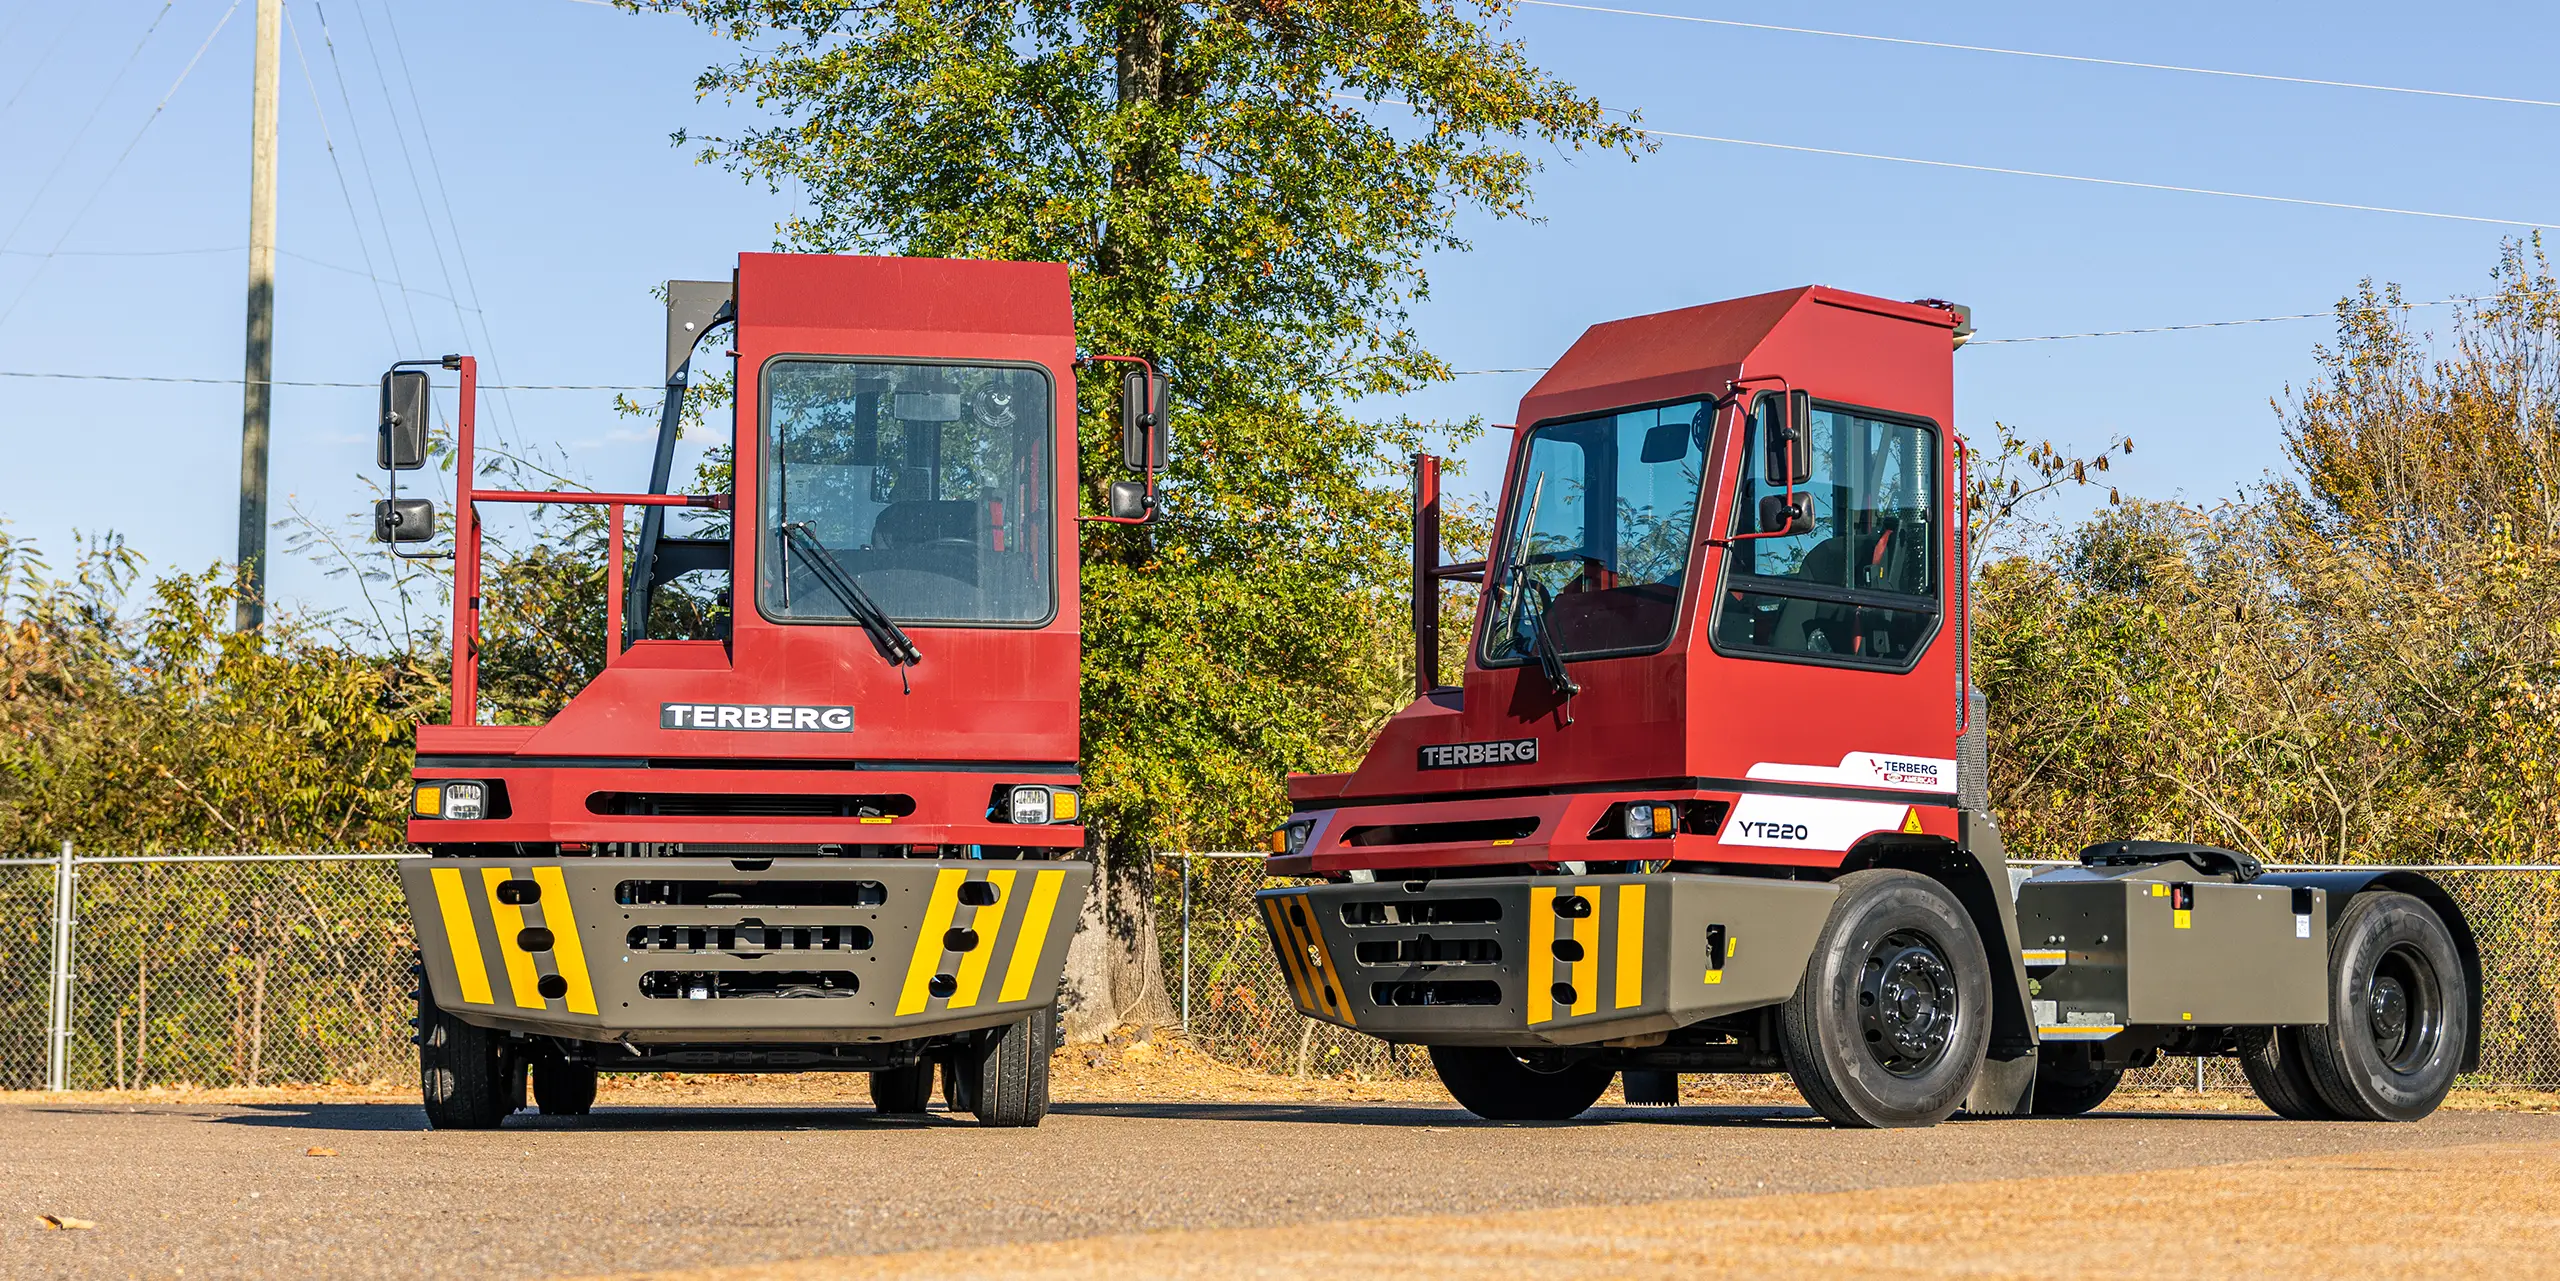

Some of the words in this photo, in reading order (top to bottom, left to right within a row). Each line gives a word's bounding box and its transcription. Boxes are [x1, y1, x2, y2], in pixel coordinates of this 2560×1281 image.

[665, 704, 851, 730] TERBERG
[1422, 741, 1535, 766] TERBERG
[1884, 761, 1938, 775] TERBERG
[1738, 820, 1808, 841] YT220
